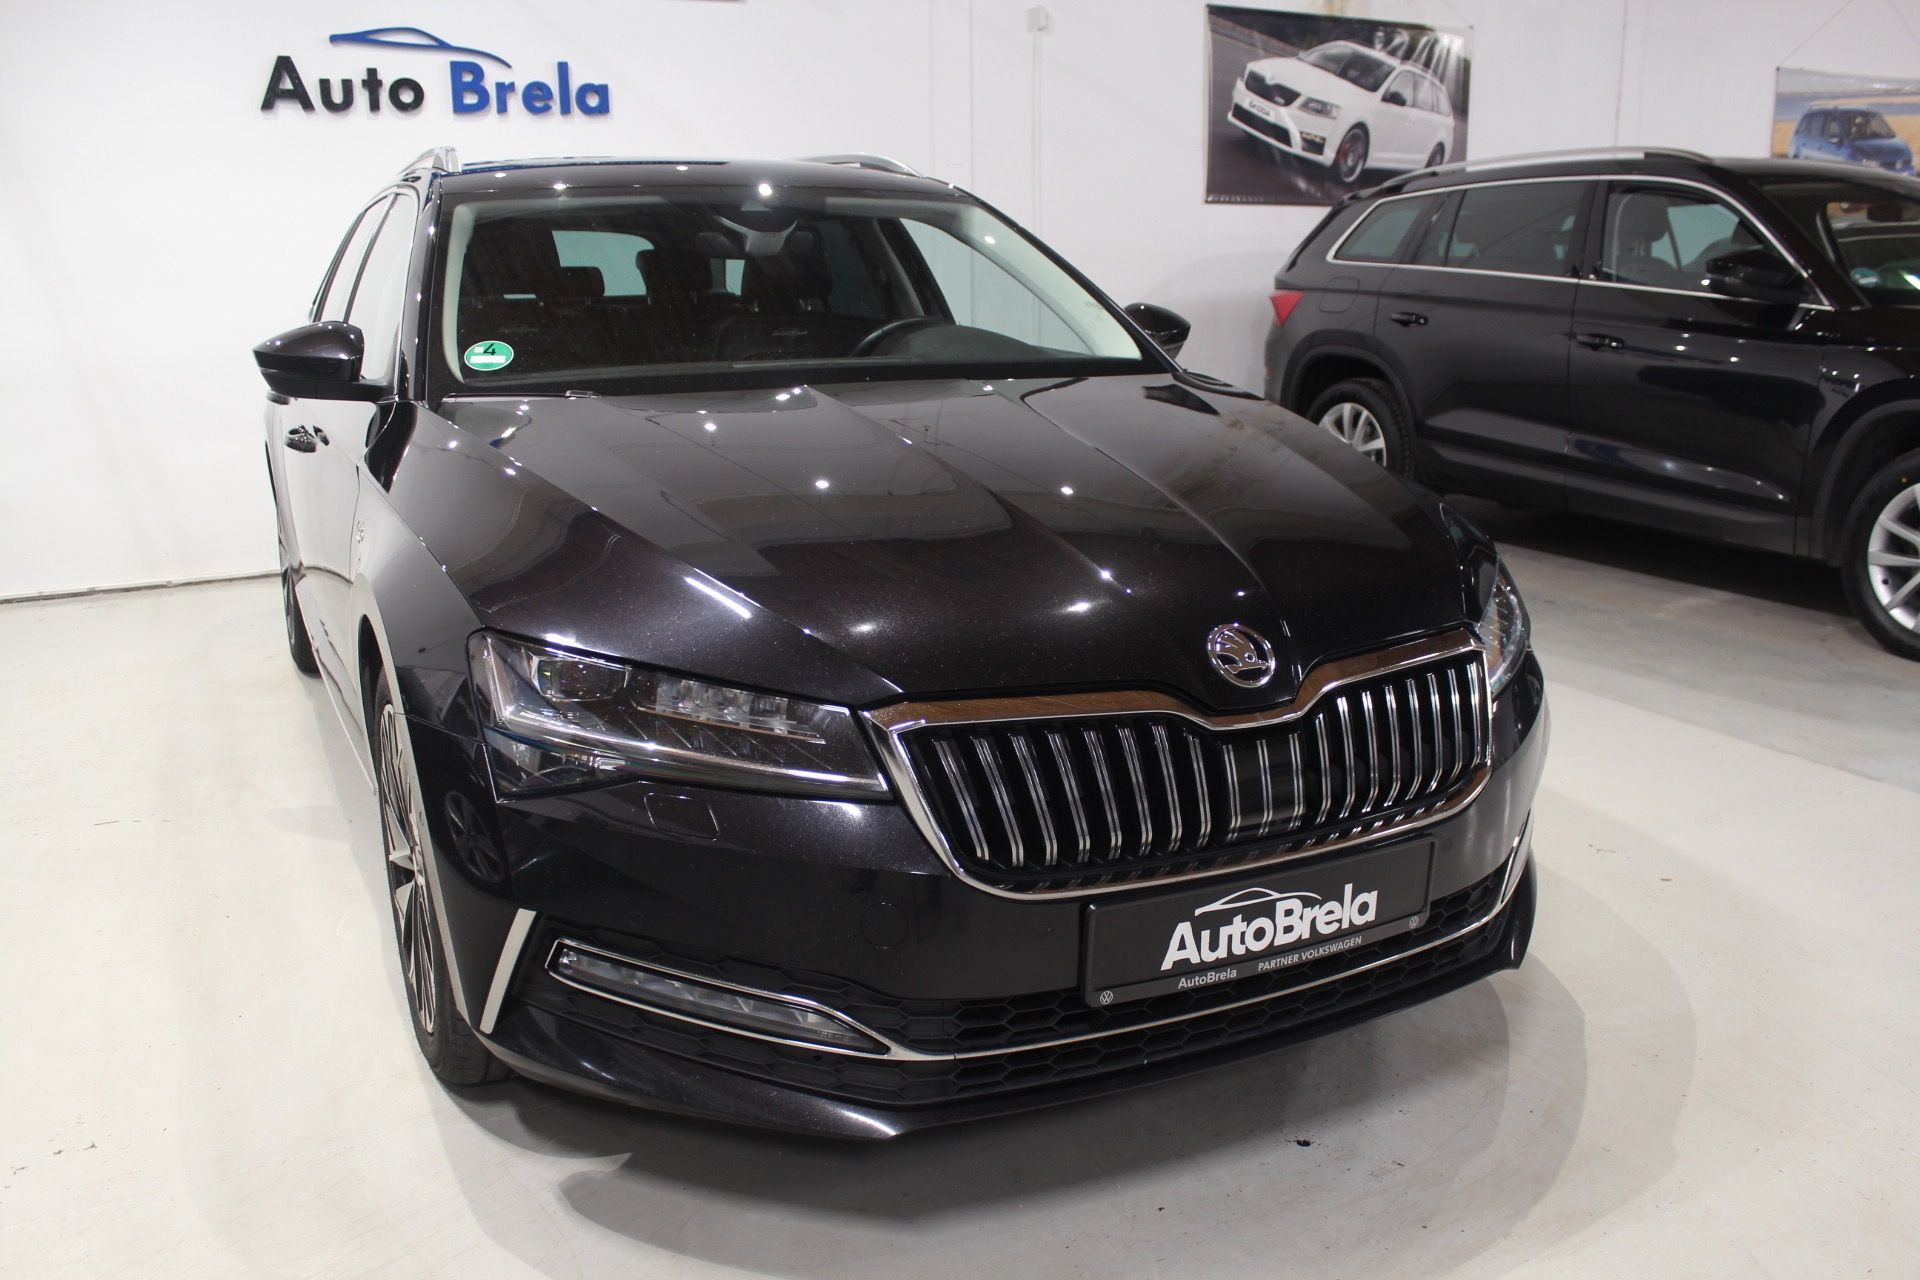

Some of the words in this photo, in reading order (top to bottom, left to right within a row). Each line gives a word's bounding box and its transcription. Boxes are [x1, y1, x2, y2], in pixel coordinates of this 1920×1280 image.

[260, 55, 425, 113] Auto
[449, 60, 610, 115] Brela
[483, 343, 496, 356] 4
[1161, 883, 1378, 971] AutoBrela
[1178, 968, 1237, 989] AutoBrela
[1258, 953, 1299, 972] PARTNER
[1301, 936, 1362, 961] VOLKSWAGEN
